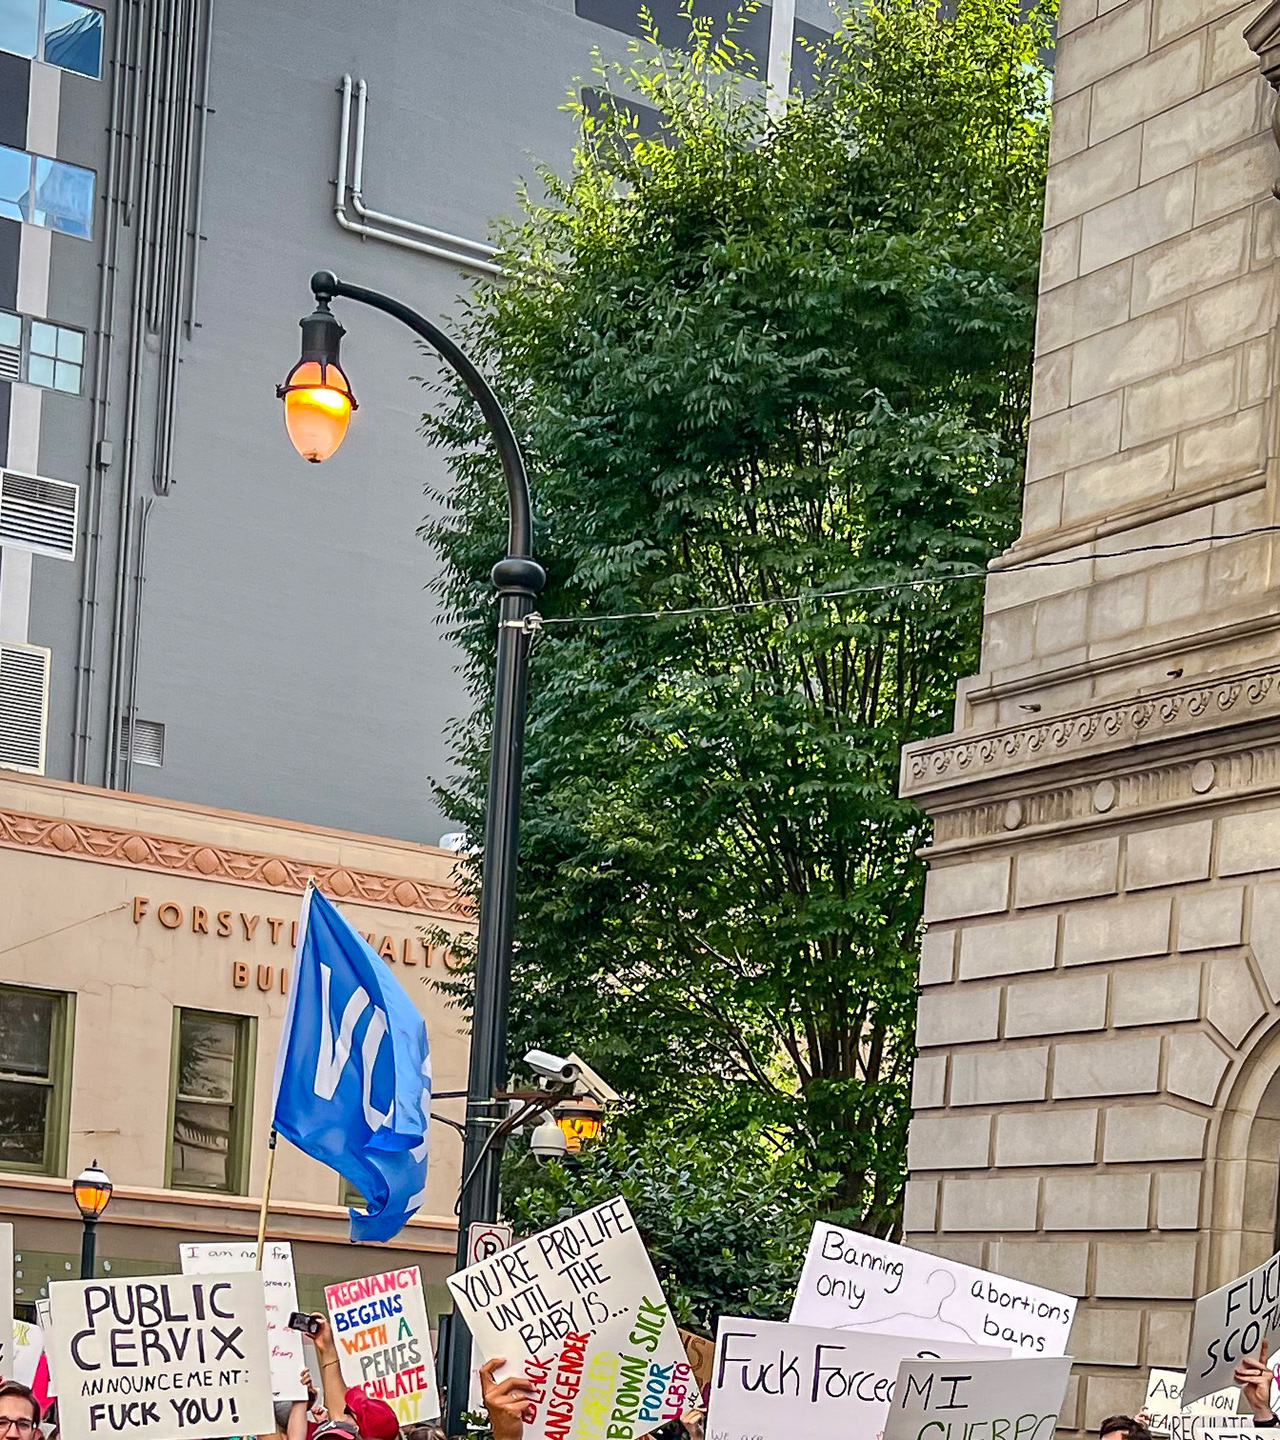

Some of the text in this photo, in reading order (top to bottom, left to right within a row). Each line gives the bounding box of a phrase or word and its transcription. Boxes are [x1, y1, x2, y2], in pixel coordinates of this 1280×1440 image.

[208, 1250, 233, 1258] am
[451, 1199, 634, 1312] YOU'RE PRO-LIFE
[326, 1267, 418, 1311] PREGNANCY
[487, 1252, 612, 1332] UNTIL THE
[821, 1230, 1071, 1325] Banning abortions
[83, 1282, 235, 1328] PUBLIC
[333, 1293, 404, 1333] BEGINS
[518, 1301, 580, 1355] BABY
[628, 1295, 668, 1353] SICK
[815, 1273, 1047, 1353] only bans
[70, 1325, 246, 1371] CERVIX
[339, 1316, 413, 1356] WITH A
[81, 1369, 251, 1397] ANNOUNCEMENT:
[359, 1338, 422, 1382] PENIS
[717, 1331, 801, 1398] Fuck
[89, 1397, 240, 1432] FUCK YOU!
[901, 1373, 973, 1411] MI
